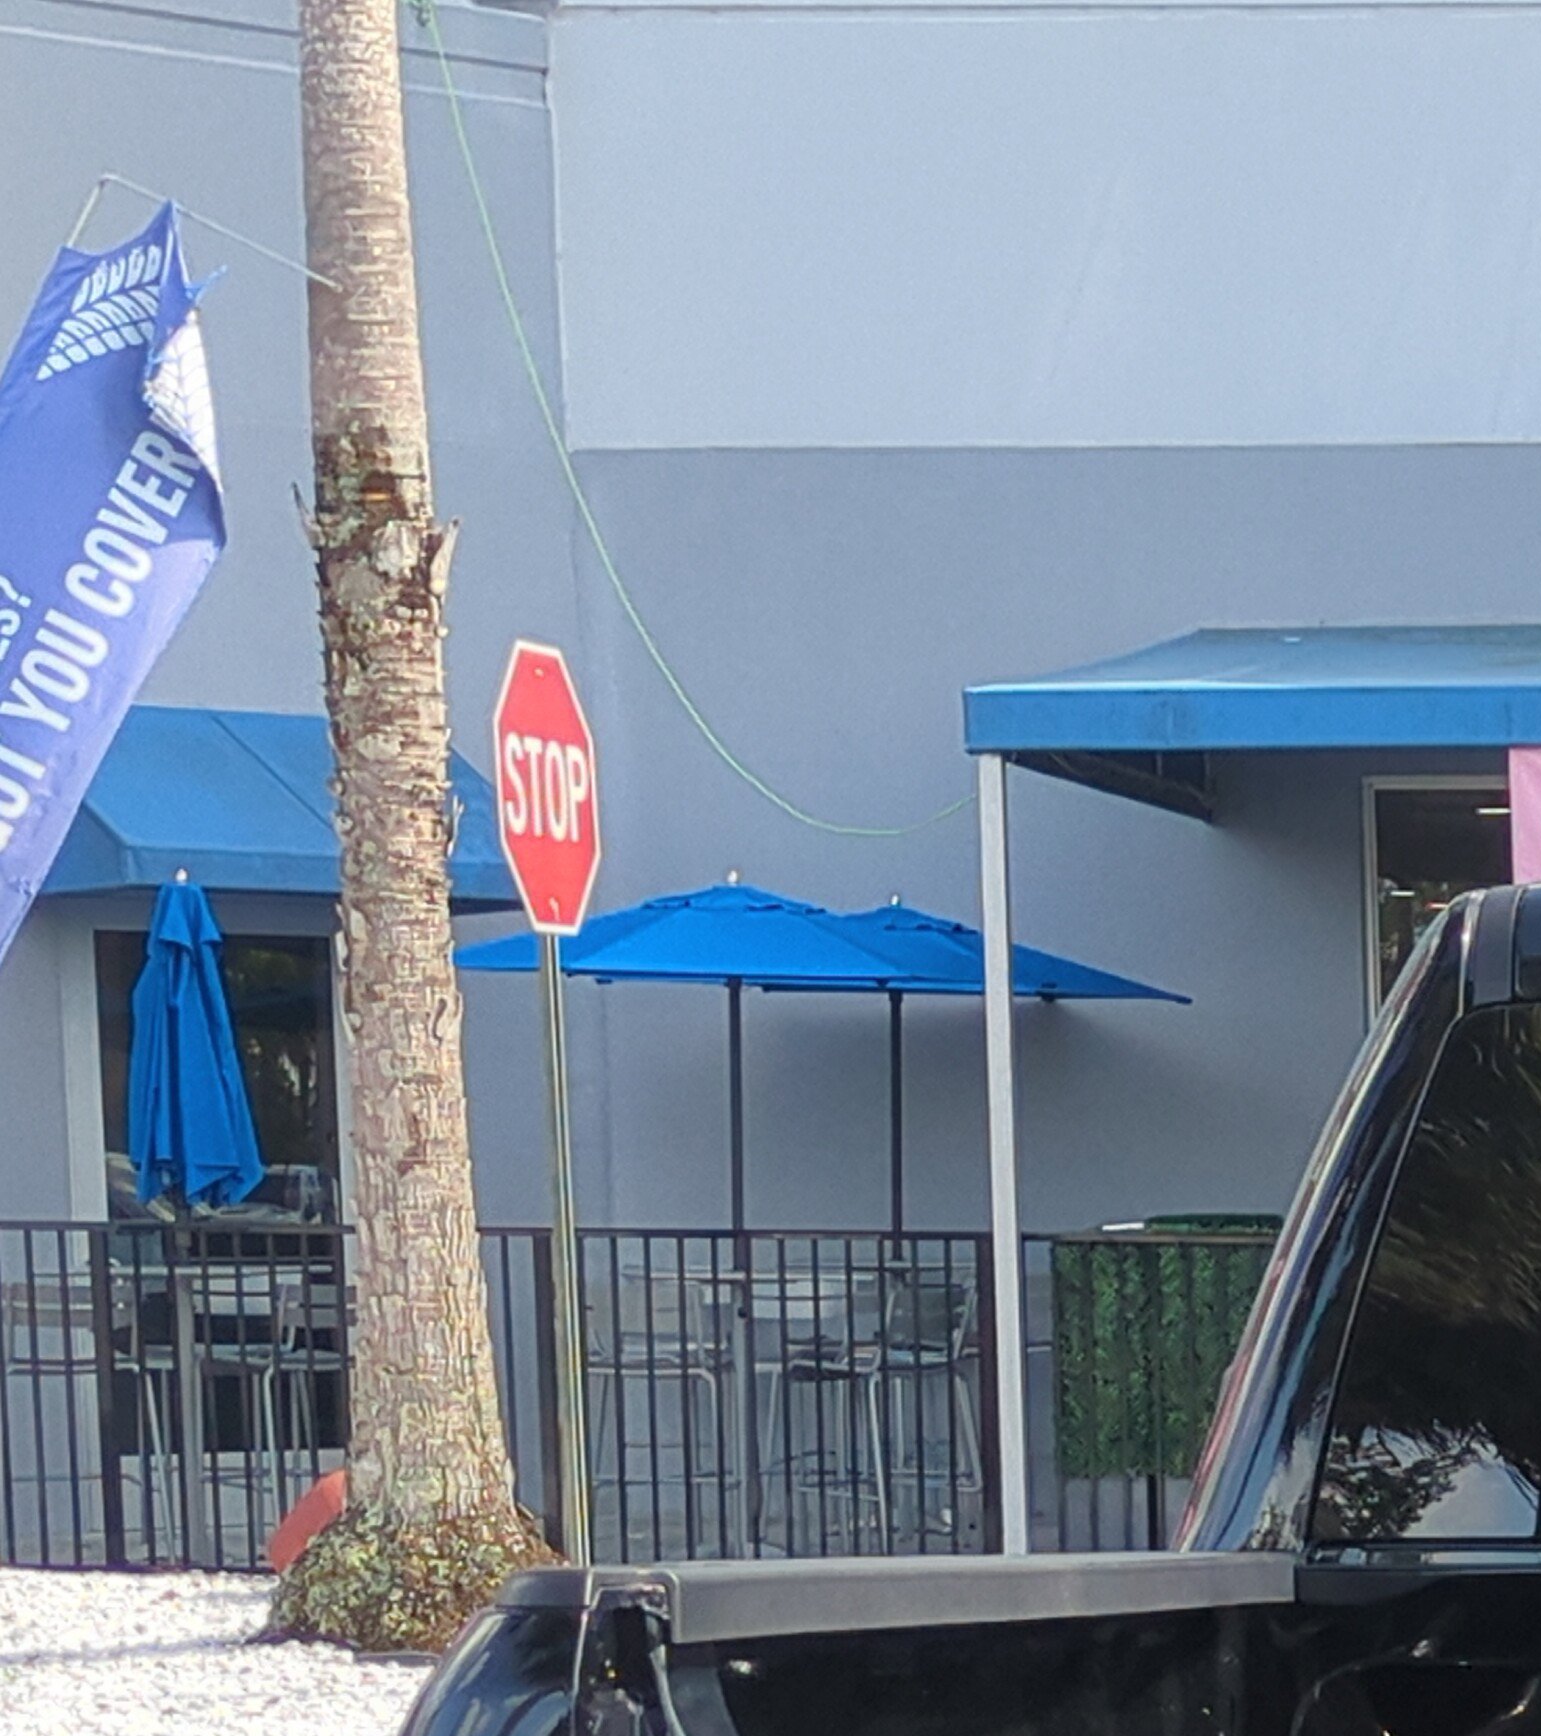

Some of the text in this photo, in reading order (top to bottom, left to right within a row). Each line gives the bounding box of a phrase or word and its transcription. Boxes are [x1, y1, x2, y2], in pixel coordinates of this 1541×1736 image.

[0, 608, 109, 733] YOU
[64, 430, 201, 618] COVER
[504, 731, 589, 843] STOP
